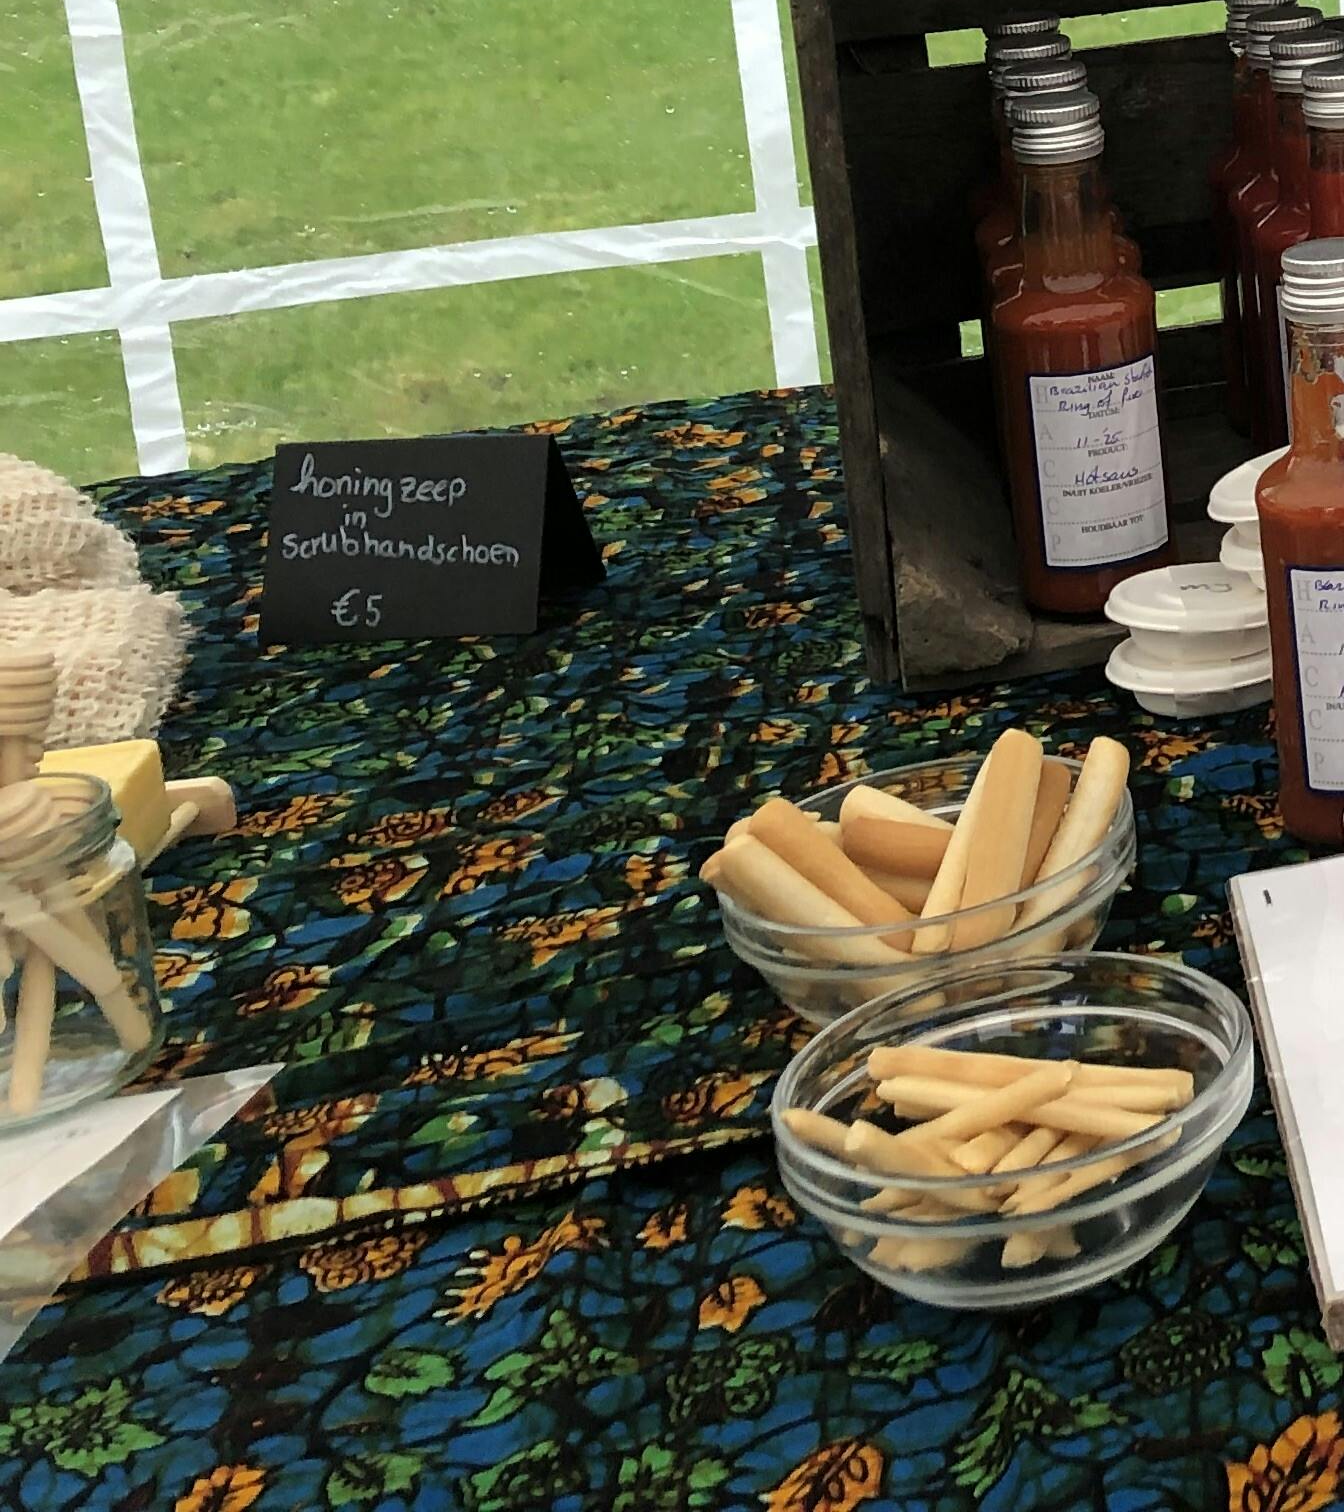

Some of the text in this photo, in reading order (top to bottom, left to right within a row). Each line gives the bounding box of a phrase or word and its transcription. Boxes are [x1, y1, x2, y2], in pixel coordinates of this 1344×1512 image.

[1058, 400, 1090, 416] Ring
[1097, 390, 1112, 409] of
[342, 503, 367, 528] in
[1081, 519, 1128, 533] HOUDBAAR
